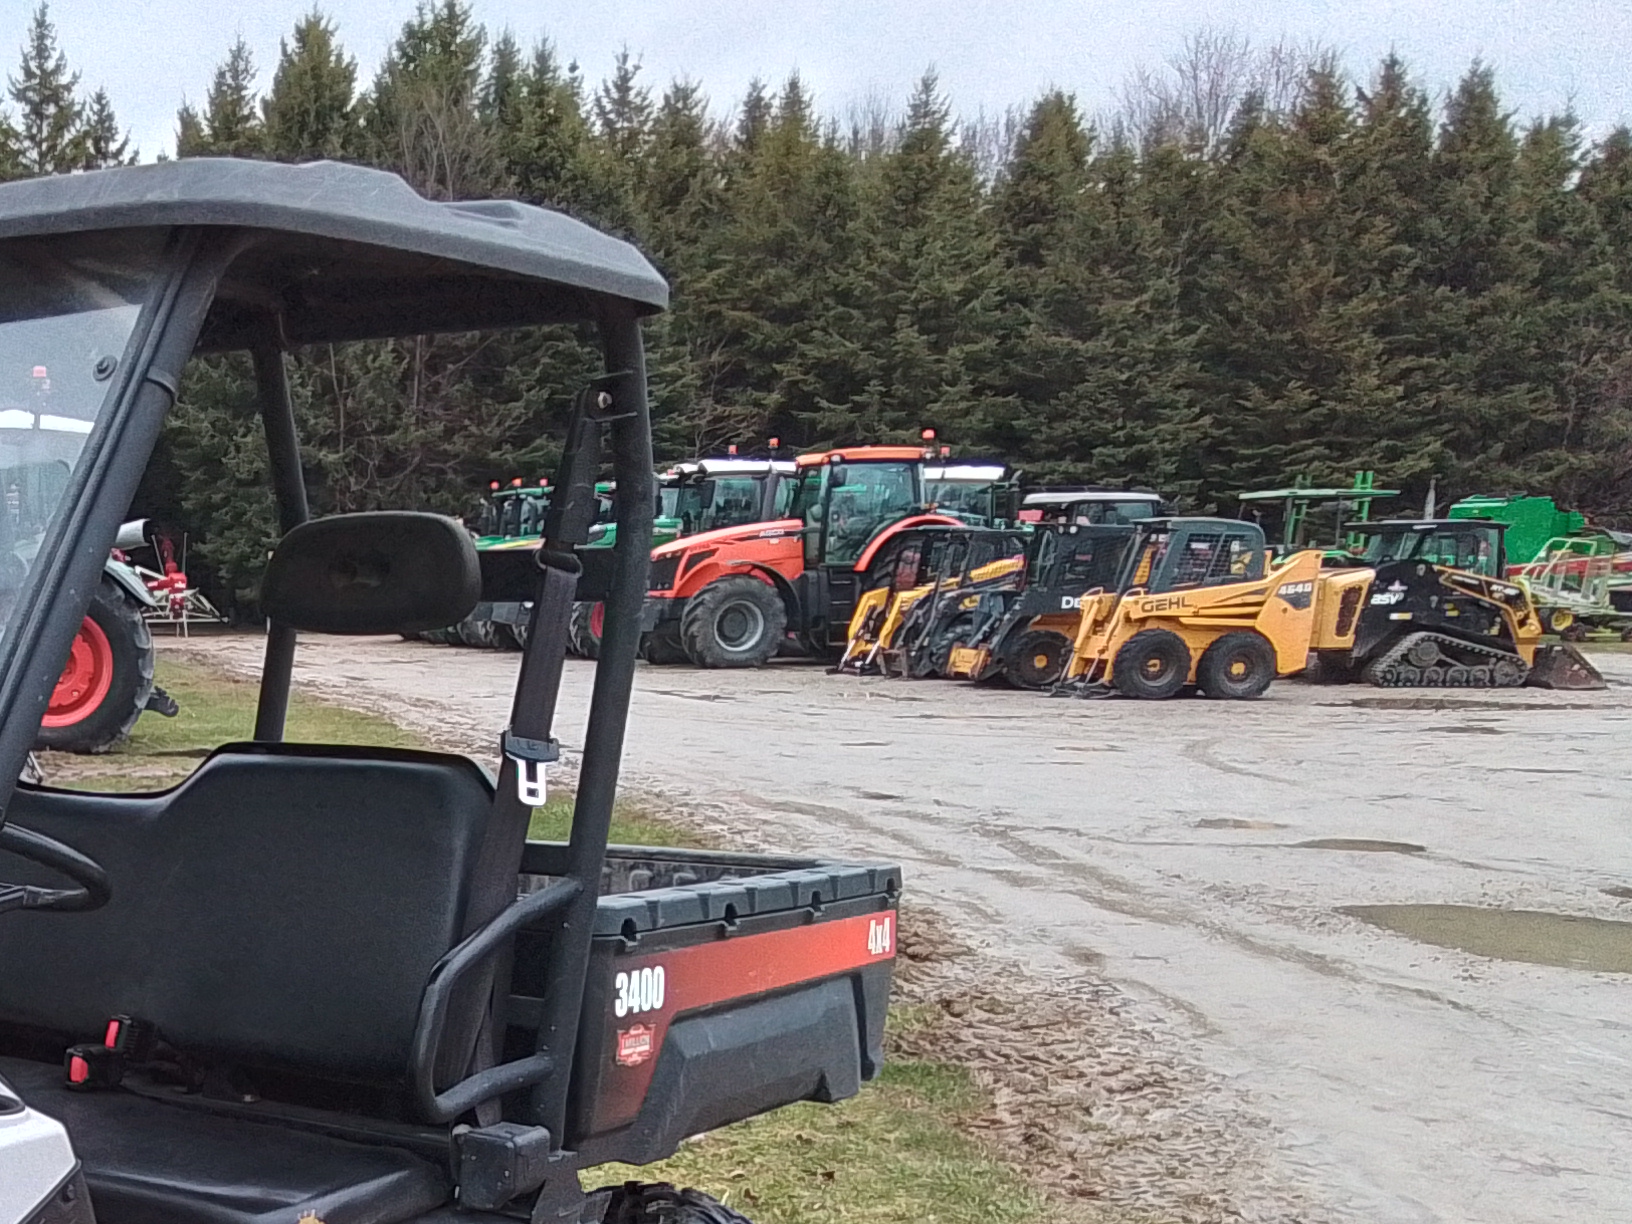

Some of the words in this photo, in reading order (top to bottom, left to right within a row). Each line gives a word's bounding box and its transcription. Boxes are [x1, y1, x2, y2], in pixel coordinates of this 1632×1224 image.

[1141, 596, 1193, 613] GEHL
[868, 917, 890, 955] 4x4
[615, 966, 665, 1017] 3400
